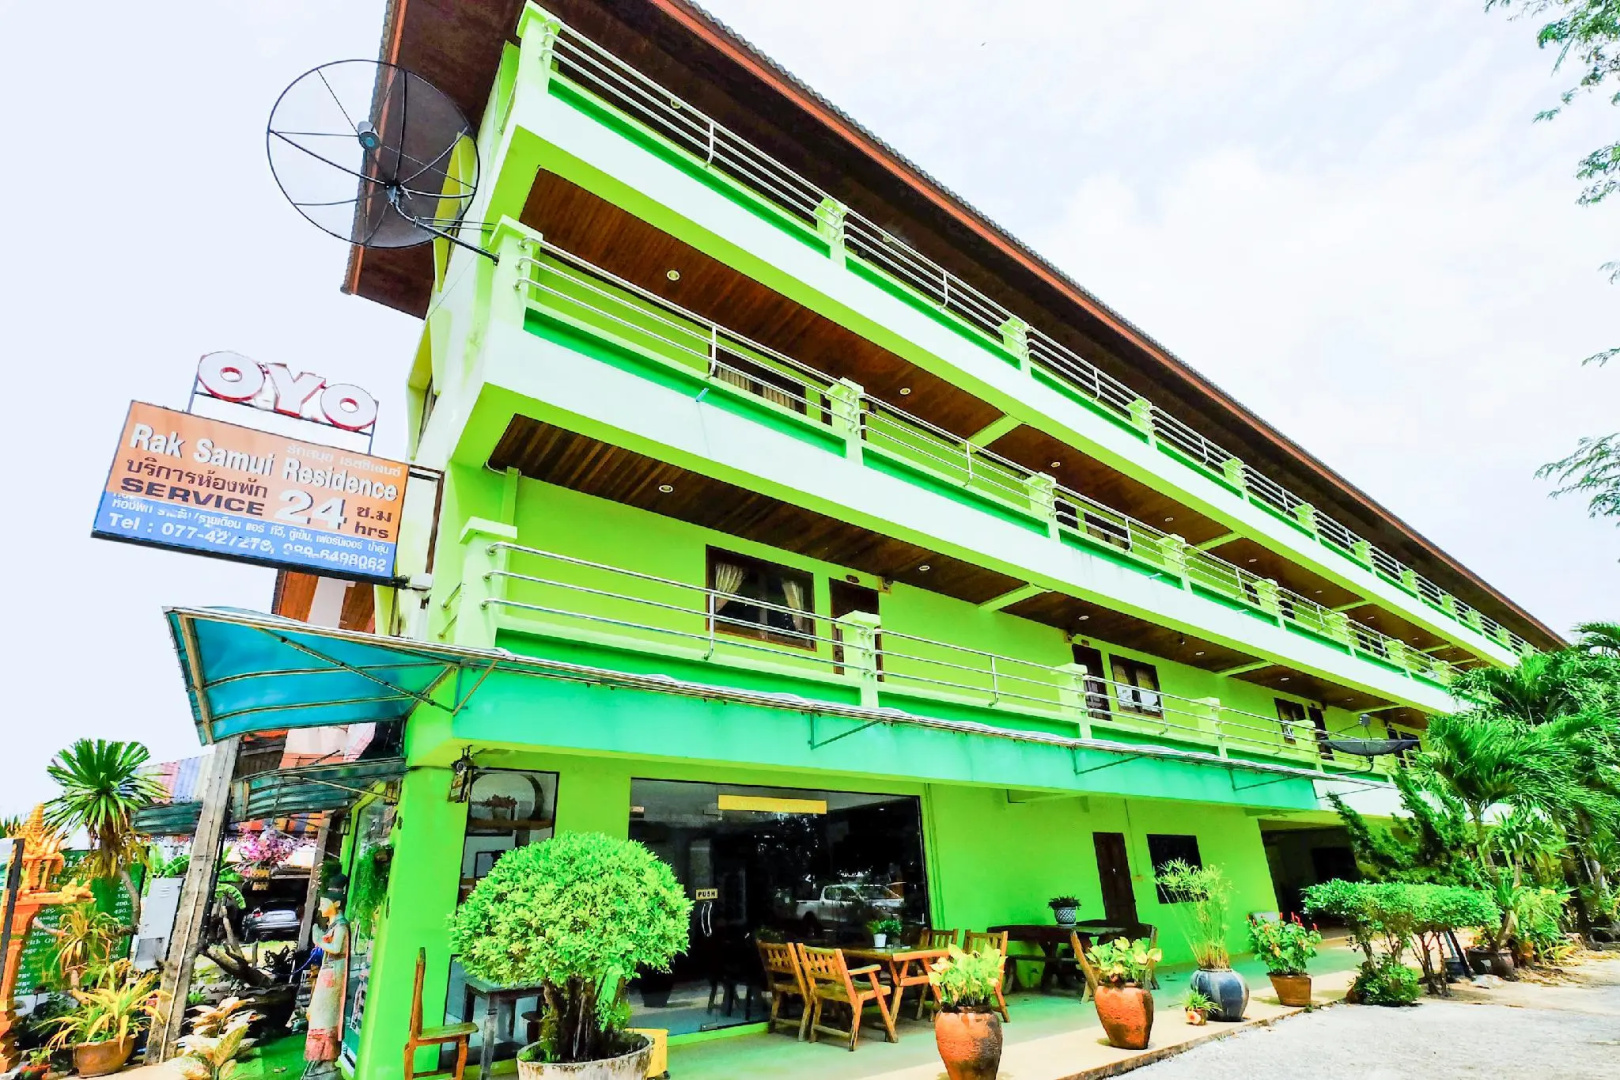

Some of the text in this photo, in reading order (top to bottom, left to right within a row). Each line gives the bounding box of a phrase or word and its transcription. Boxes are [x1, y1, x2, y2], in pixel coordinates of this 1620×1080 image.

[198, 350, 379, 431] OYO
[129, 423, 398, 501] Rak Samui Residence
[121, 477, 264, 517] SERVICE
[274, 488, 347, 529] 24
[109, 512, 141, 531] Tel
[354, 521, 389, 539] hrs
